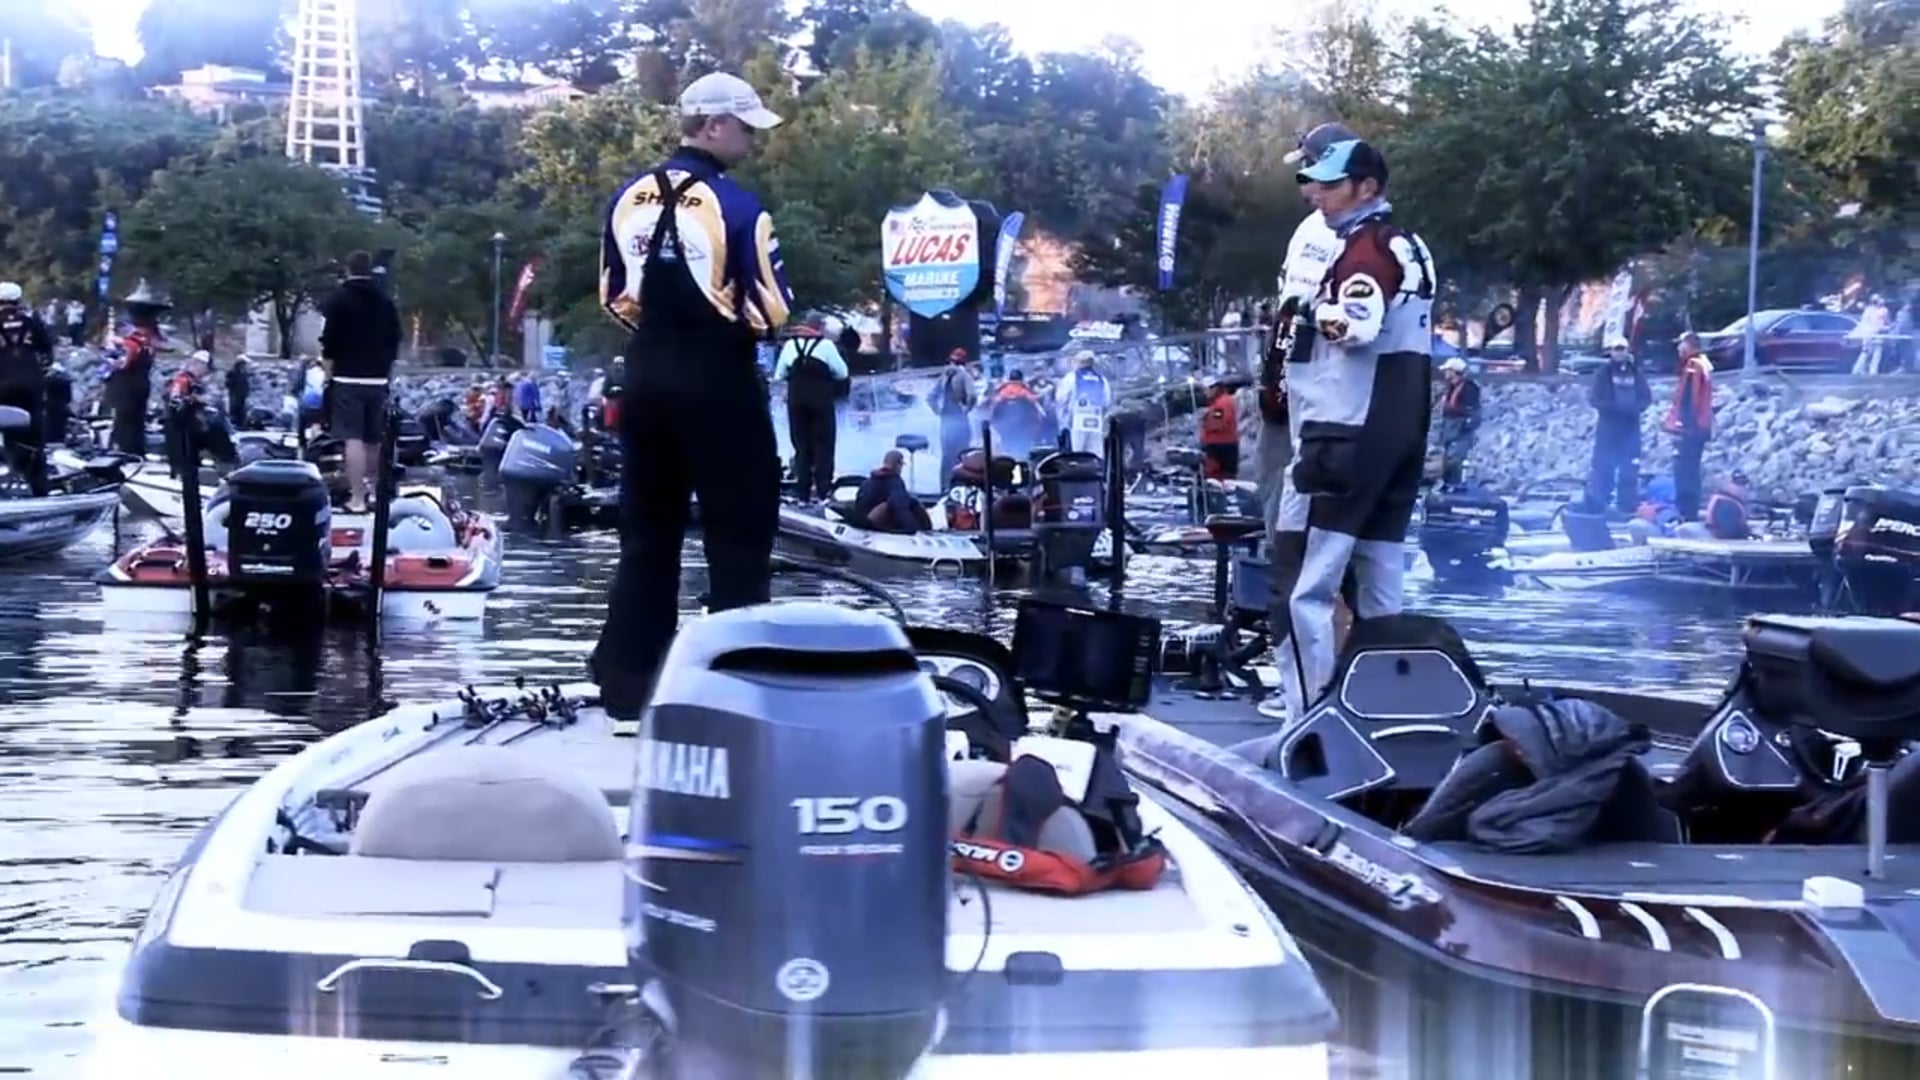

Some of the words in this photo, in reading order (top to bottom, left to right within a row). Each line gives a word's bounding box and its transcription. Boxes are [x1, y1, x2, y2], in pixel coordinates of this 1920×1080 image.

[633, 191, 702, 208] SHRP
[890, 233, 971, 266] LUCAS
[244, 511, 292, 530] 250
[789, 795, 909, 835] 150
